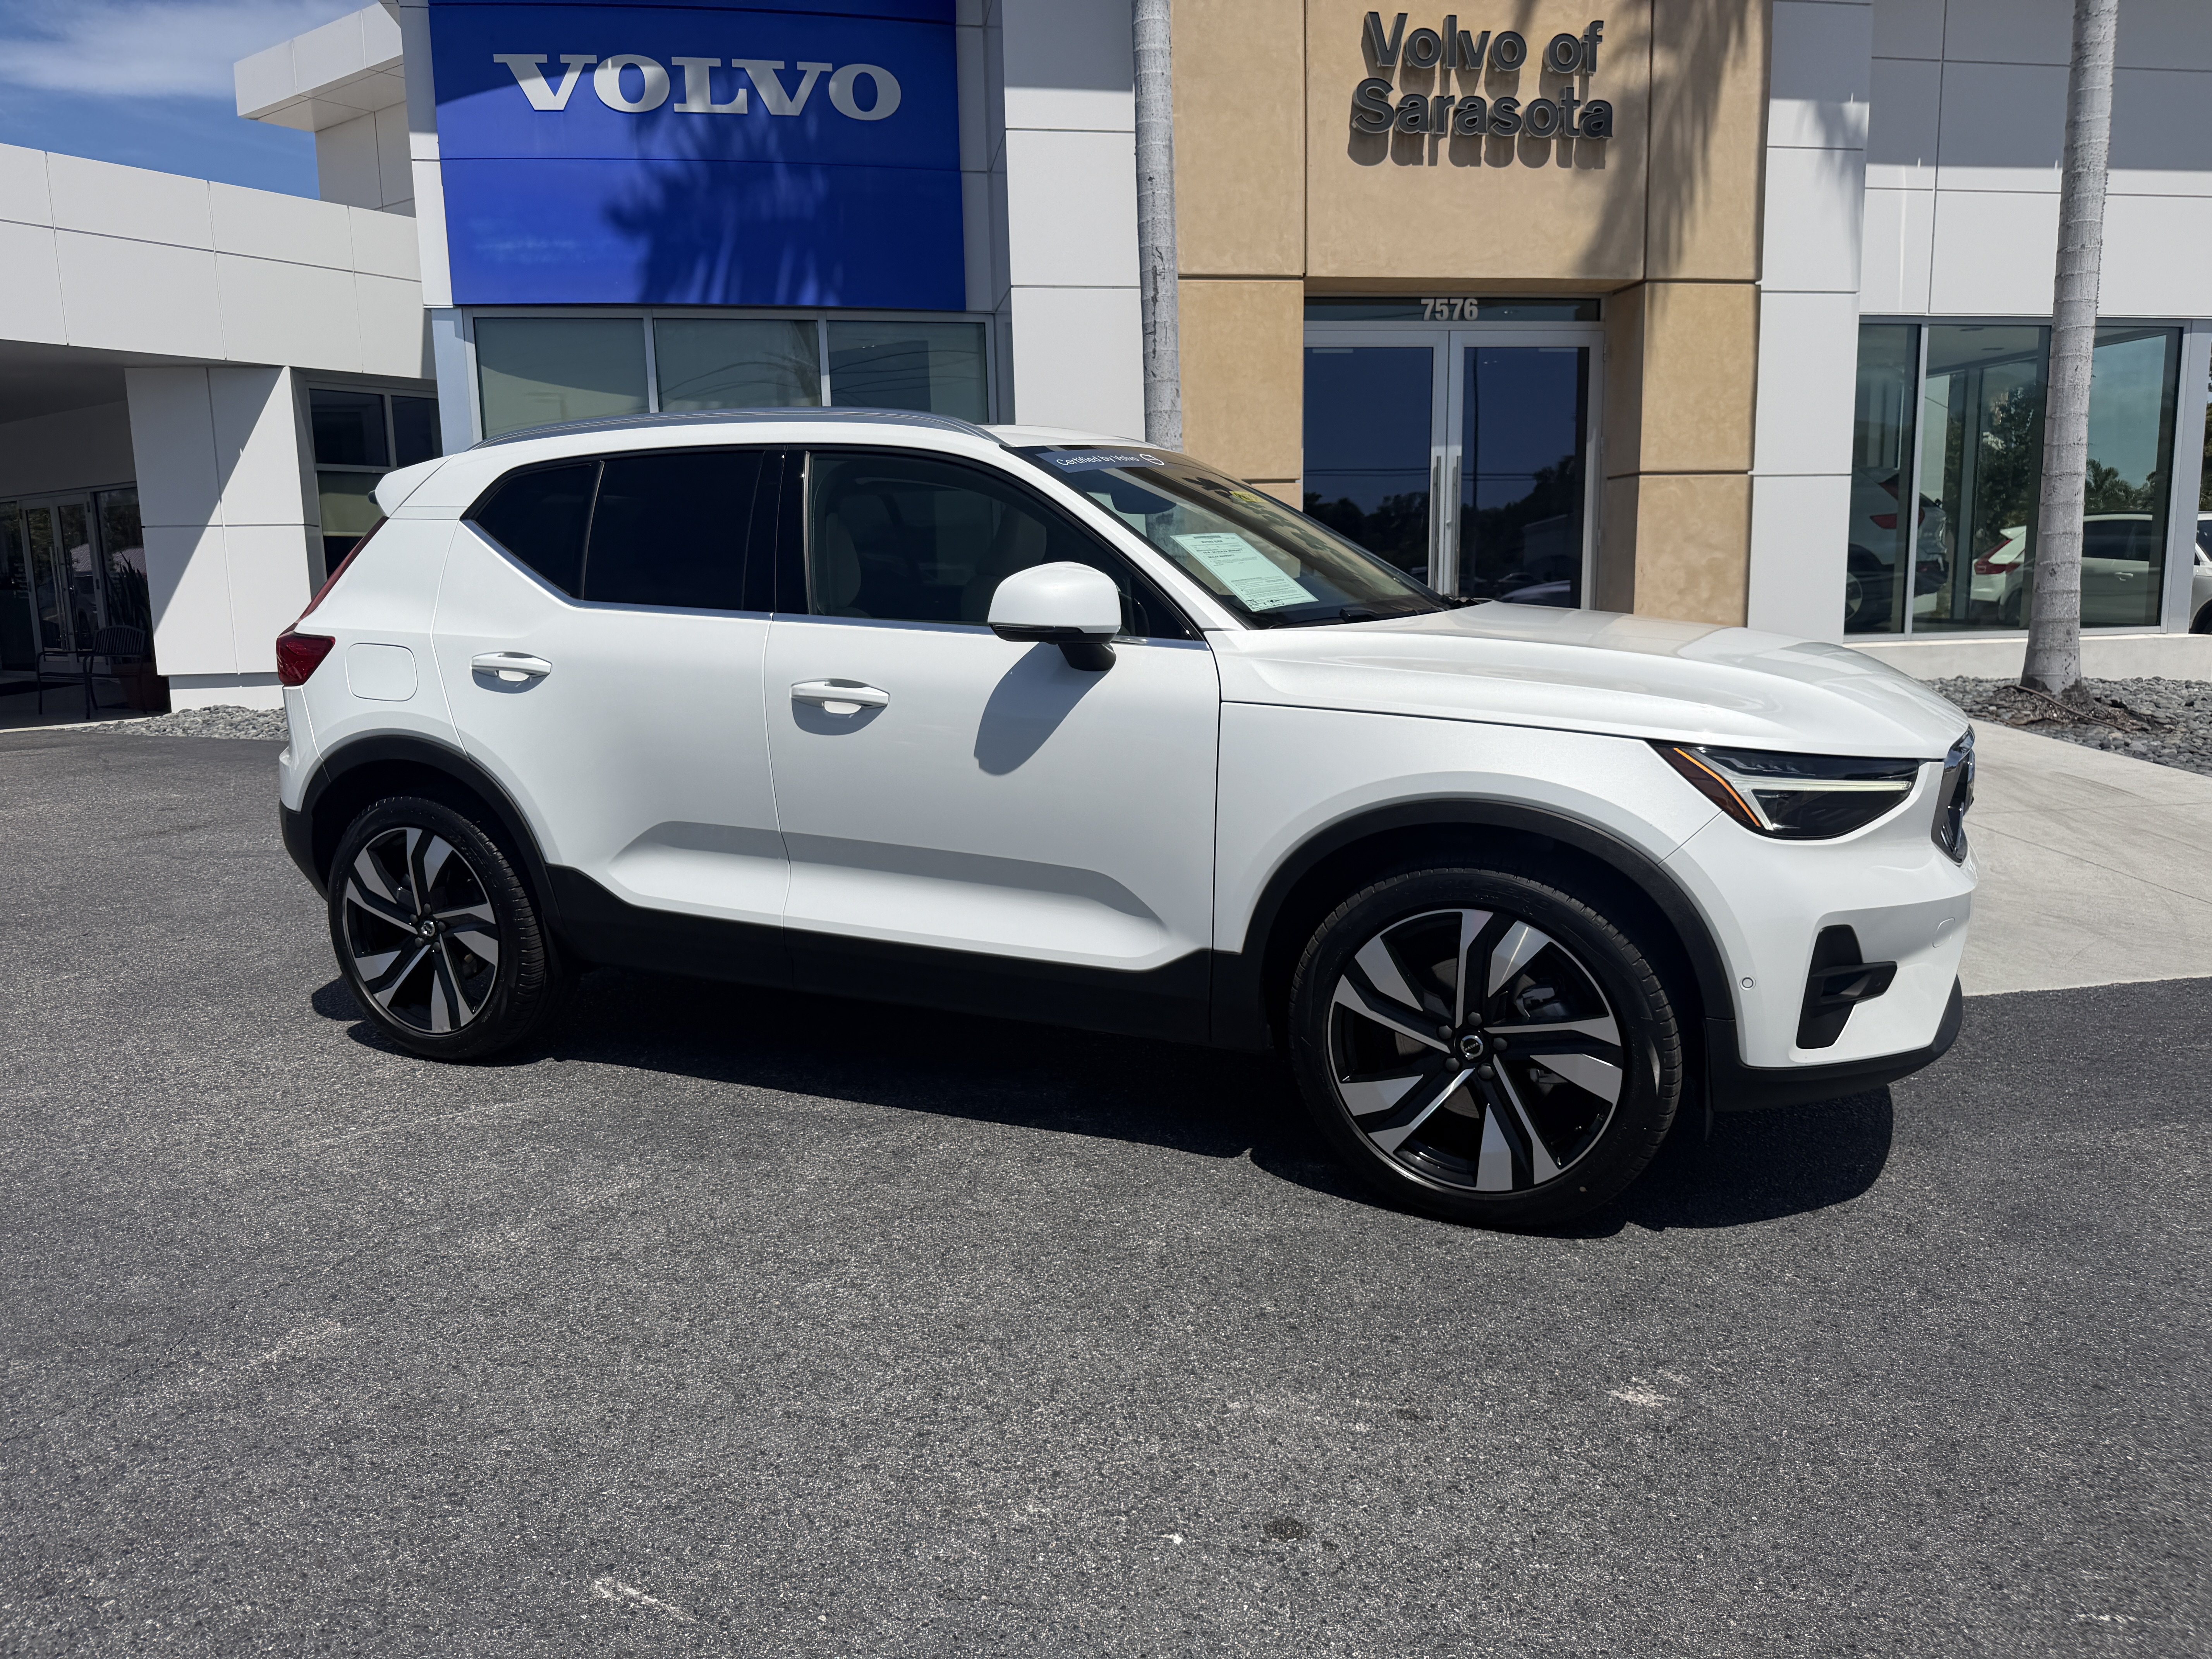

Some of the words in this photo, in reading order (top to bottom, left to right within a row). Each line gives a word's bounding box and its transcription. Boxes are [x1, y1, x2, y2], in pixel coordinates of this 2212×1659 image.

[1365, 11, 1527, 72] Volvo
[1548, 20, 1604, 74] of
[493, 53, 902, 121] VOLVO
[1353, 77, 1613, 139] Sarasota
[1420, 298, 1478, 321] 7576
[1056, 455, 1102, 465] Certified
